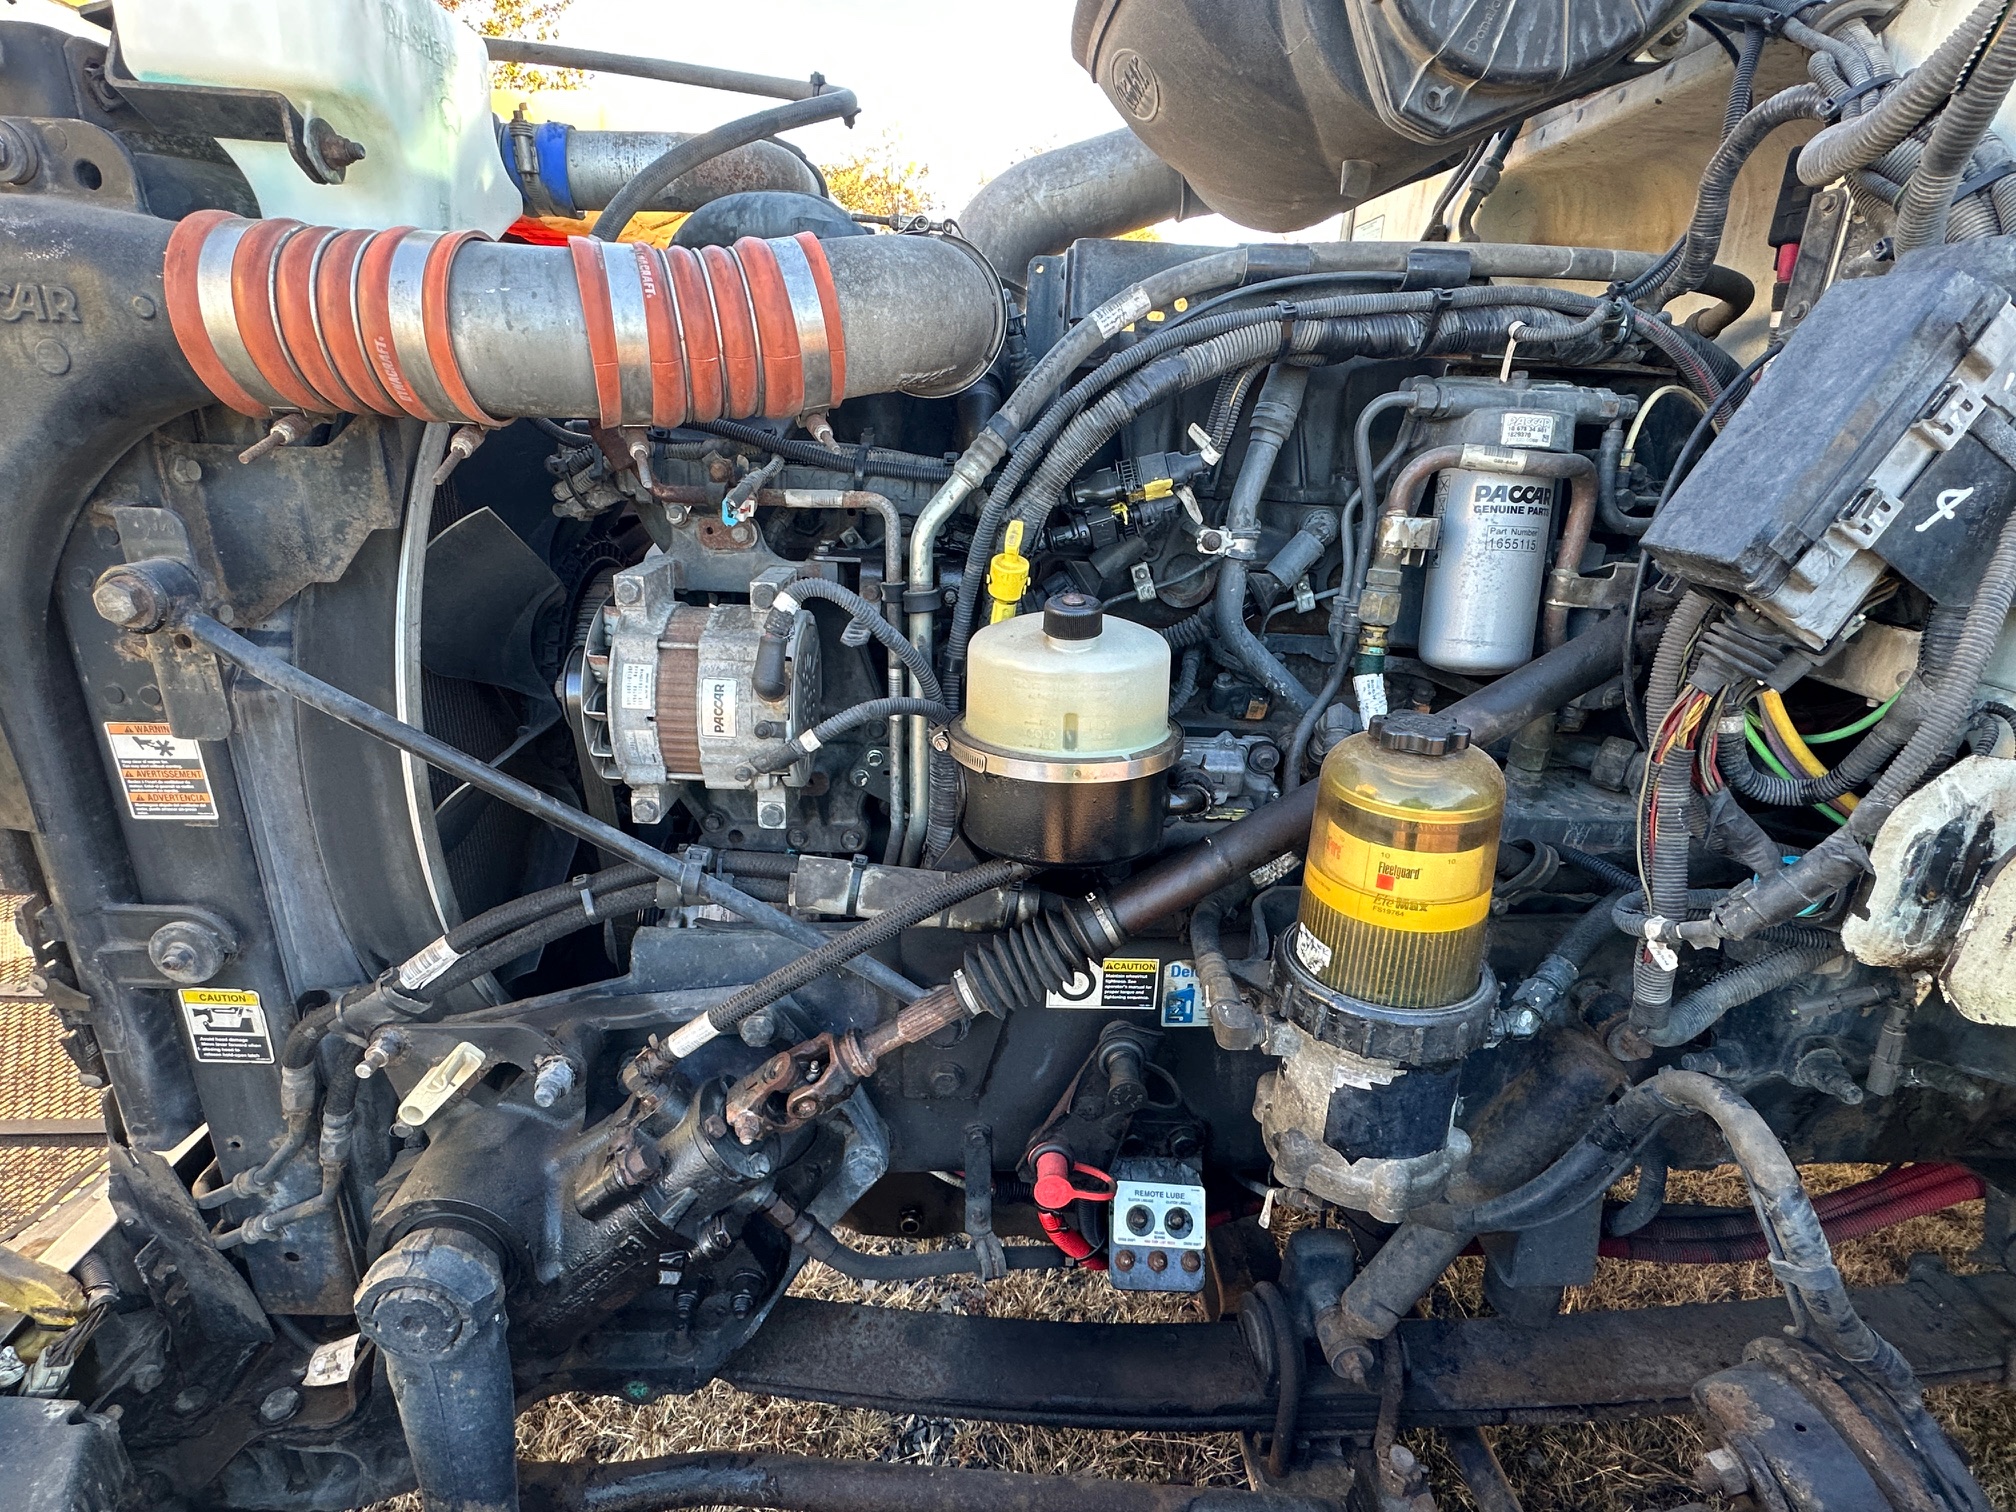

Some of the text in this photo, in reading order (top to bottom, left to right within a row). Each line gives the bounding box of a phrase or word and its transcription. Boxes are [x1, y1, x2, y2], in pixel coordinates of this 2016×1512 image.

[1507, 416, 1551, 428] PACCAR
[1474, 485, 1552, 506] PACCAR
[1473, 504, 1550, 517] GENUINE PARTS
[1489, 527, 1538, 536] Part Number
[1489, 538, 1536, 550] 1655115
[714, 684, 725, 733] PACCAR
[134, 725, 170, 733] WARNIN
[136, 770, 201, 778] AVERTISSEMENT
[147, 794, 206, 802] ADVERTENCIA
[1378, 861, 1421, 880] Fleetguard
[1372, 905, 1405, 917] FS19764
[1114, 962, 1156, 970] CAUTION
[199, 994, 247, 1002] CAUTION
[1134, 1190, 1185, 1200] REMOTE LUBE
